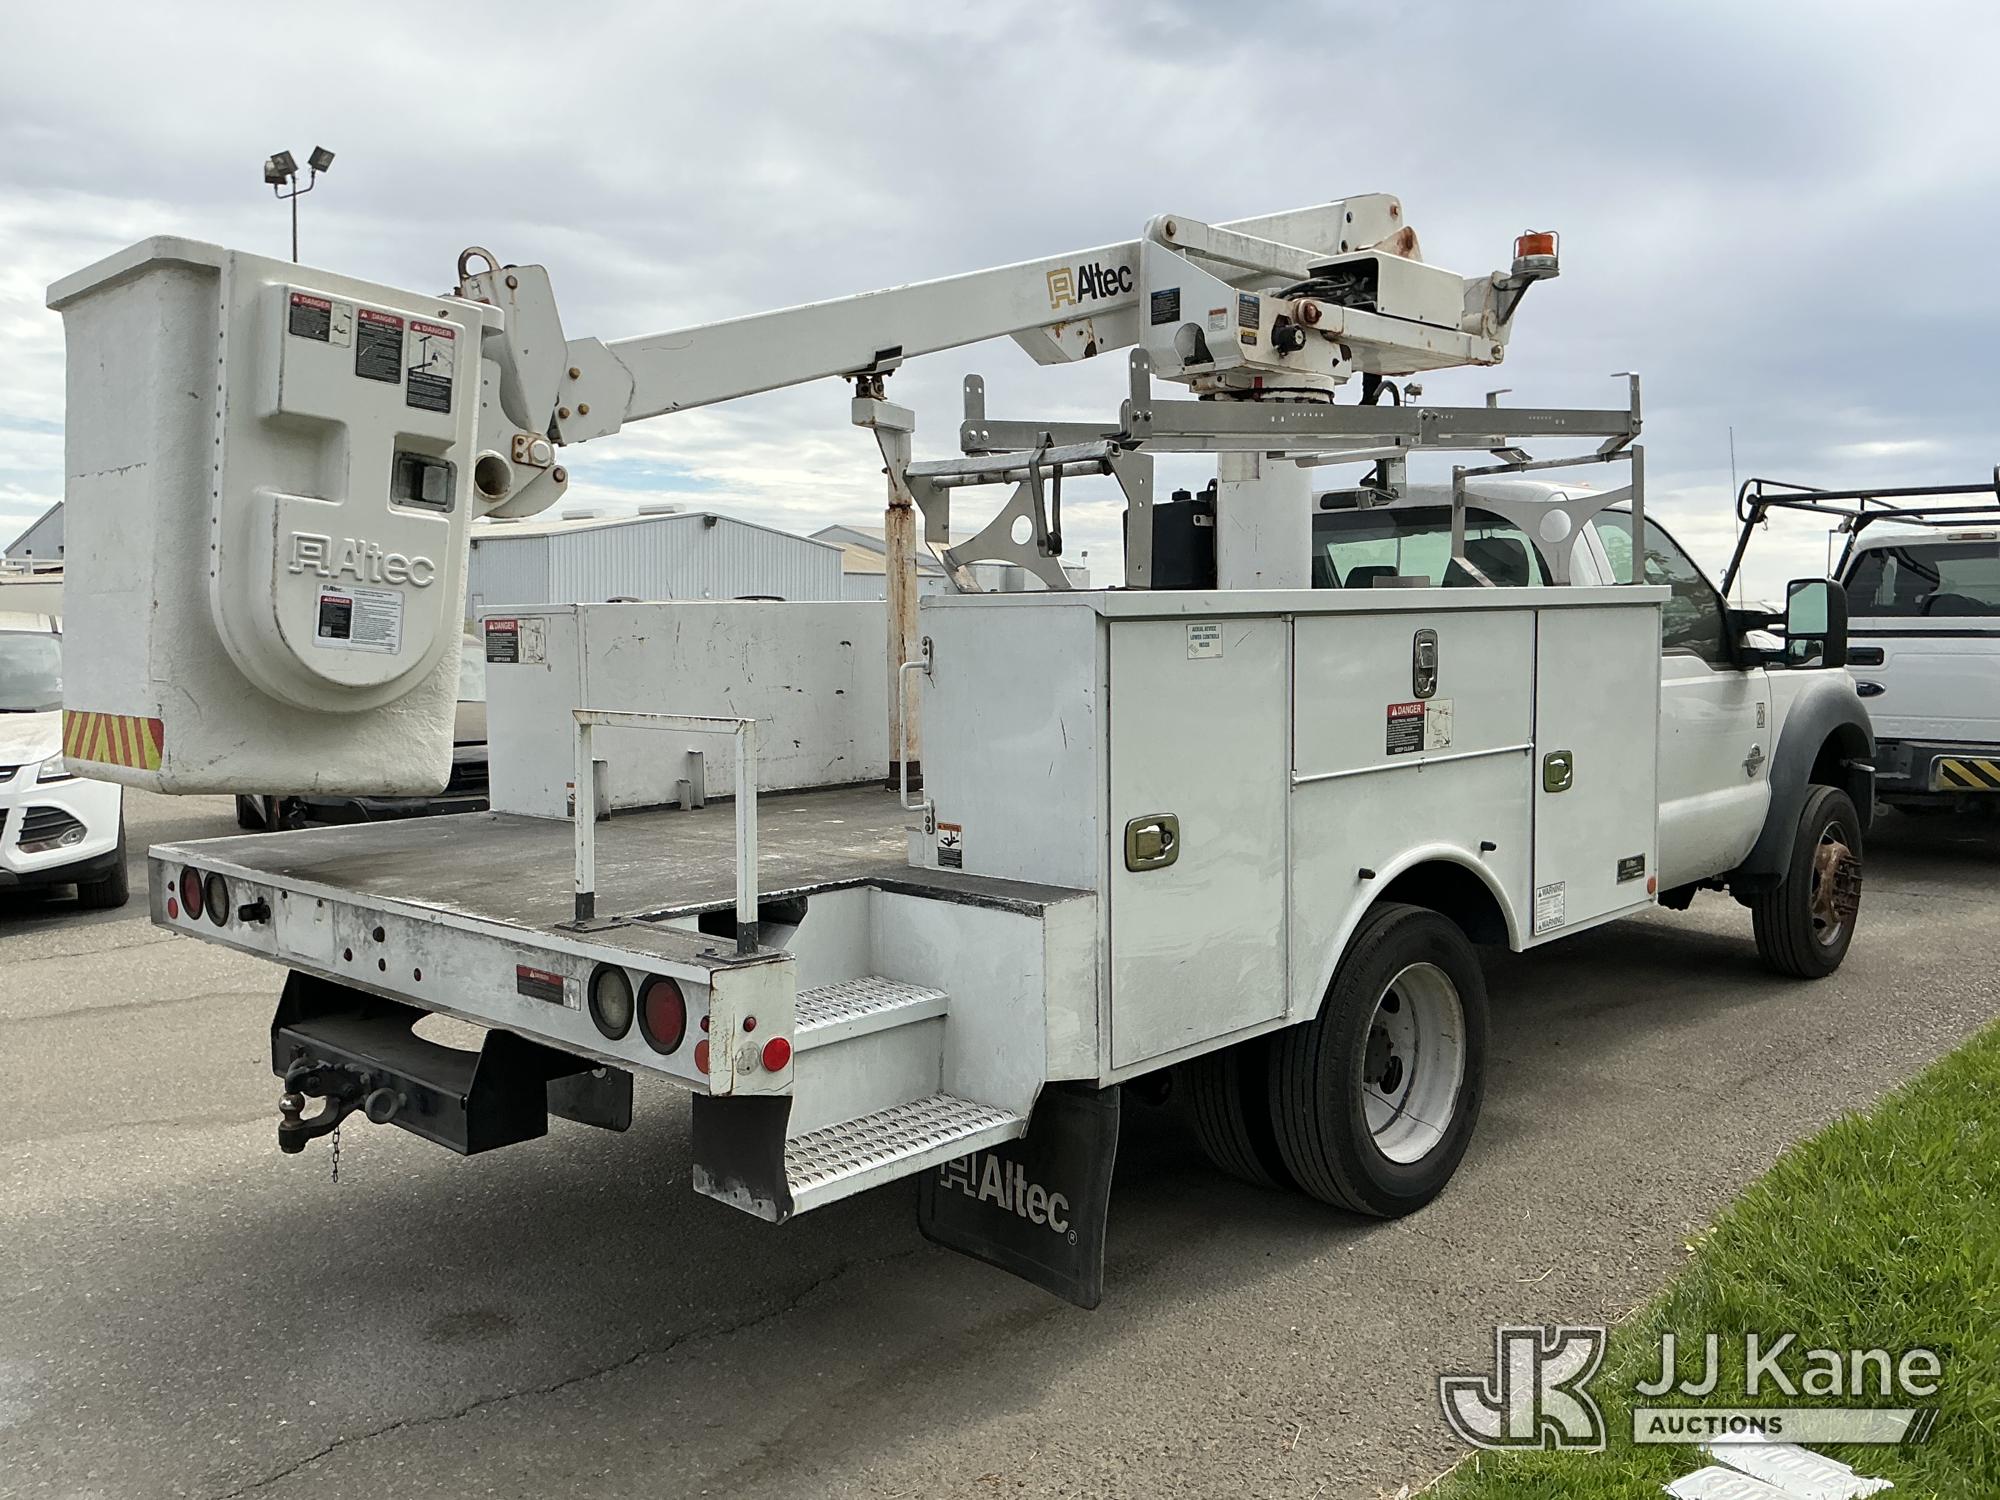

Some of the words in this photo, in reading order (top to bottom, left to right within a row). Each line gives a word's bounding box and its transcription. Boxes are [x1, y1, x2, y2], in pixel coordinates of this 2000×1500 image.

[1078, 262, 1132, 303] Altec
[301, 296, 331, 309] DANGER
[371, 312, 397, 324] DANGER
[421, 325, 452, 337] DANGER
[331, 537, 436, 588] Altec
[494, 621, 515, 630] DANGER
[1397, 704, 1422, 715] DANGER
[1542, 883, 1563, 896] WARNING
[1542, 915, 1563, 928] WARNING
[978, 1153, 1070, 1234] Altec
